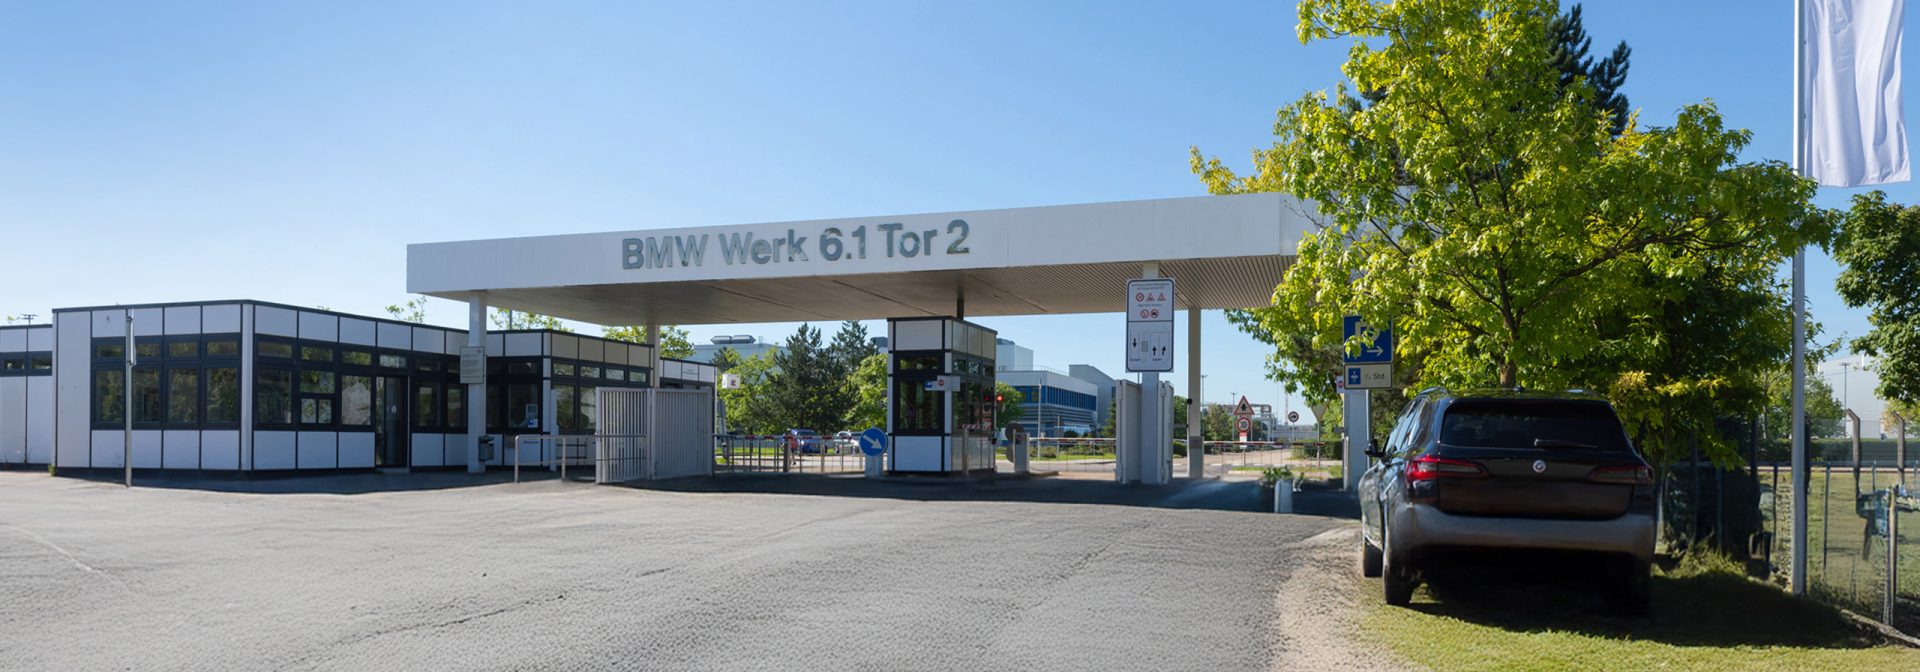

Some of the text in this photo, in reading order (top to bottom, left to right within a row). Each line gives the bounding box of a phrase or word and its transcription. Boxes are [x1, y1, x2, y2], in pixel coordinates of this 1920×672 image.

[622, 219, 970, 270] BMW Werk 6.1 Tor 2
